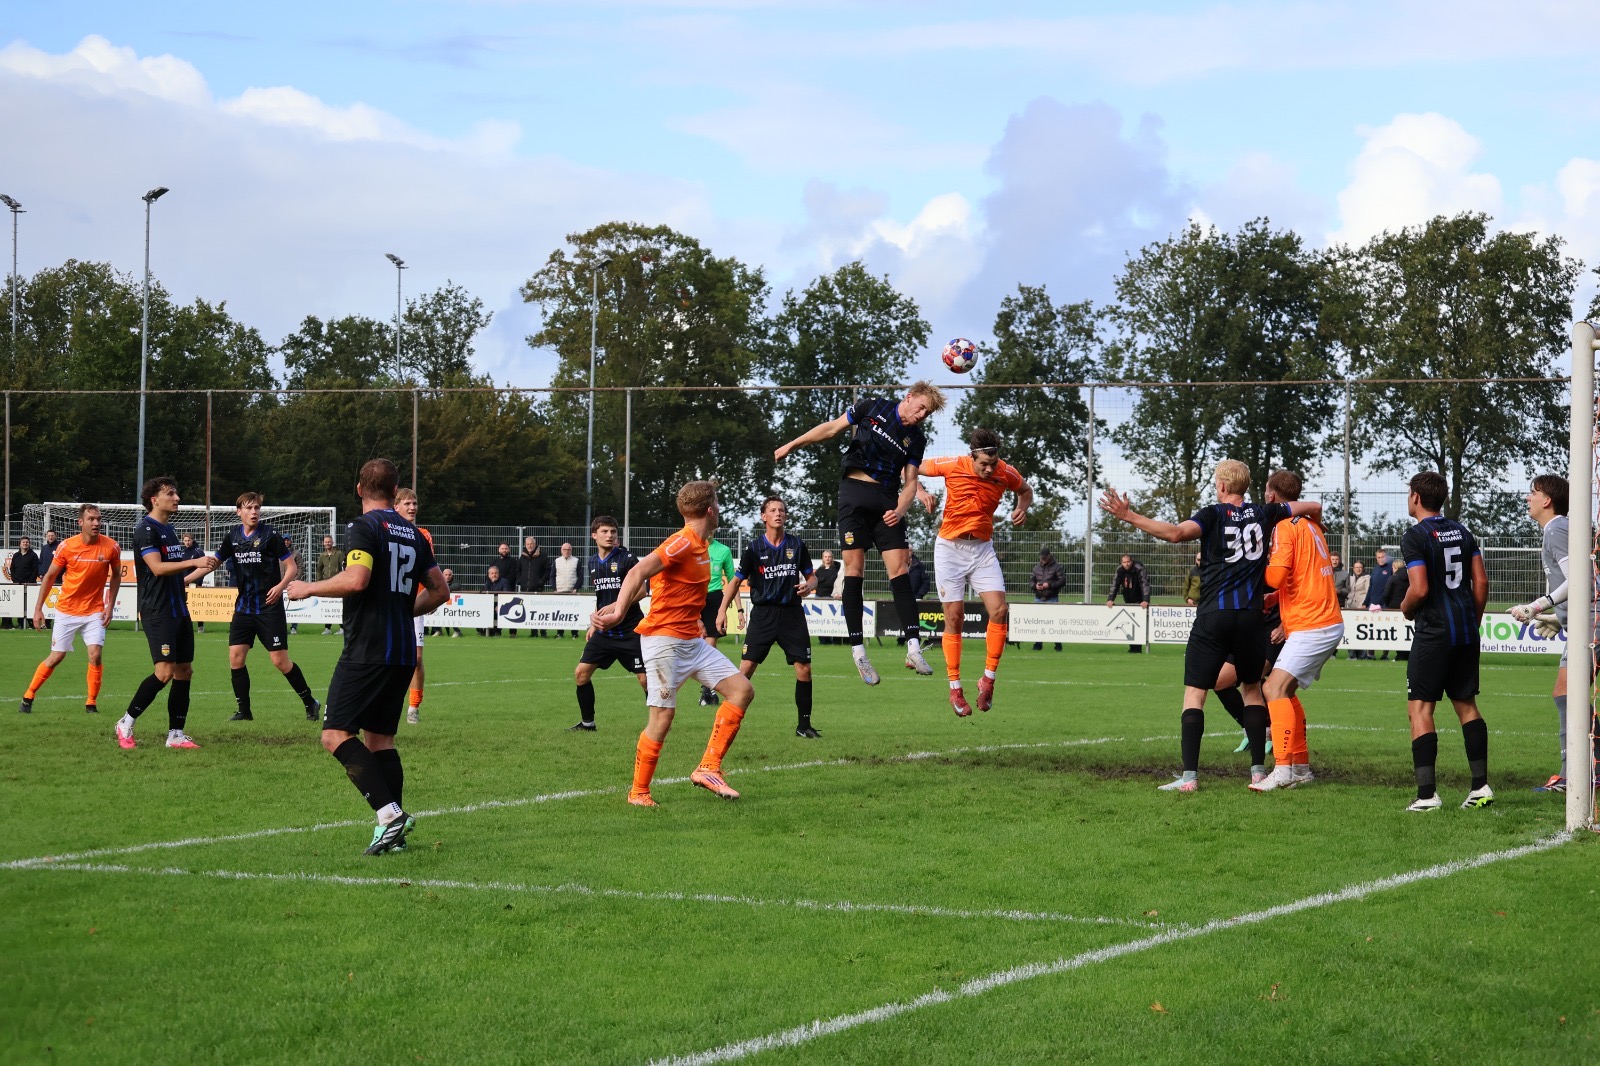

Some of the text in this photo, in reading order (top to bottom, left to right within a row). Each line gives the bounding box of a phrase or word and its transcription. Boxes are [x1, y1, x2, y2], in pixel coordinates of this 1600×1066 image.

[387, 522, 415, 534] KUIPERS
[1437, 529, 1461, 537] KUIPERS
[390, 529, 416, 540] LEMMER
[1224, 522, 1263, 563] 30
[388, 541, 417, 595] 12
[764, 564, 797, 573] KUIPERS
[1444, 546, 1463, 590] 5
[764, 570, 797, 580] LEMMER
[443, 607, 481, 618] Partners
[919, 611, 944, 623] recyc
[1151, 607, 1182, 618] Hielke
[1013, 617, 1099, 626] SJ Veldman 06-19921690
[1153, 618, 1194, 629] klussenb
[1013, 627, 1111, 638] Timmer & Onderhoudsbedrijf
[1153, 629, 1191, 640] 06-305
[1356, 623, 1398, 642] Sint
[1481, 643, 1547, 653] fuel the future
